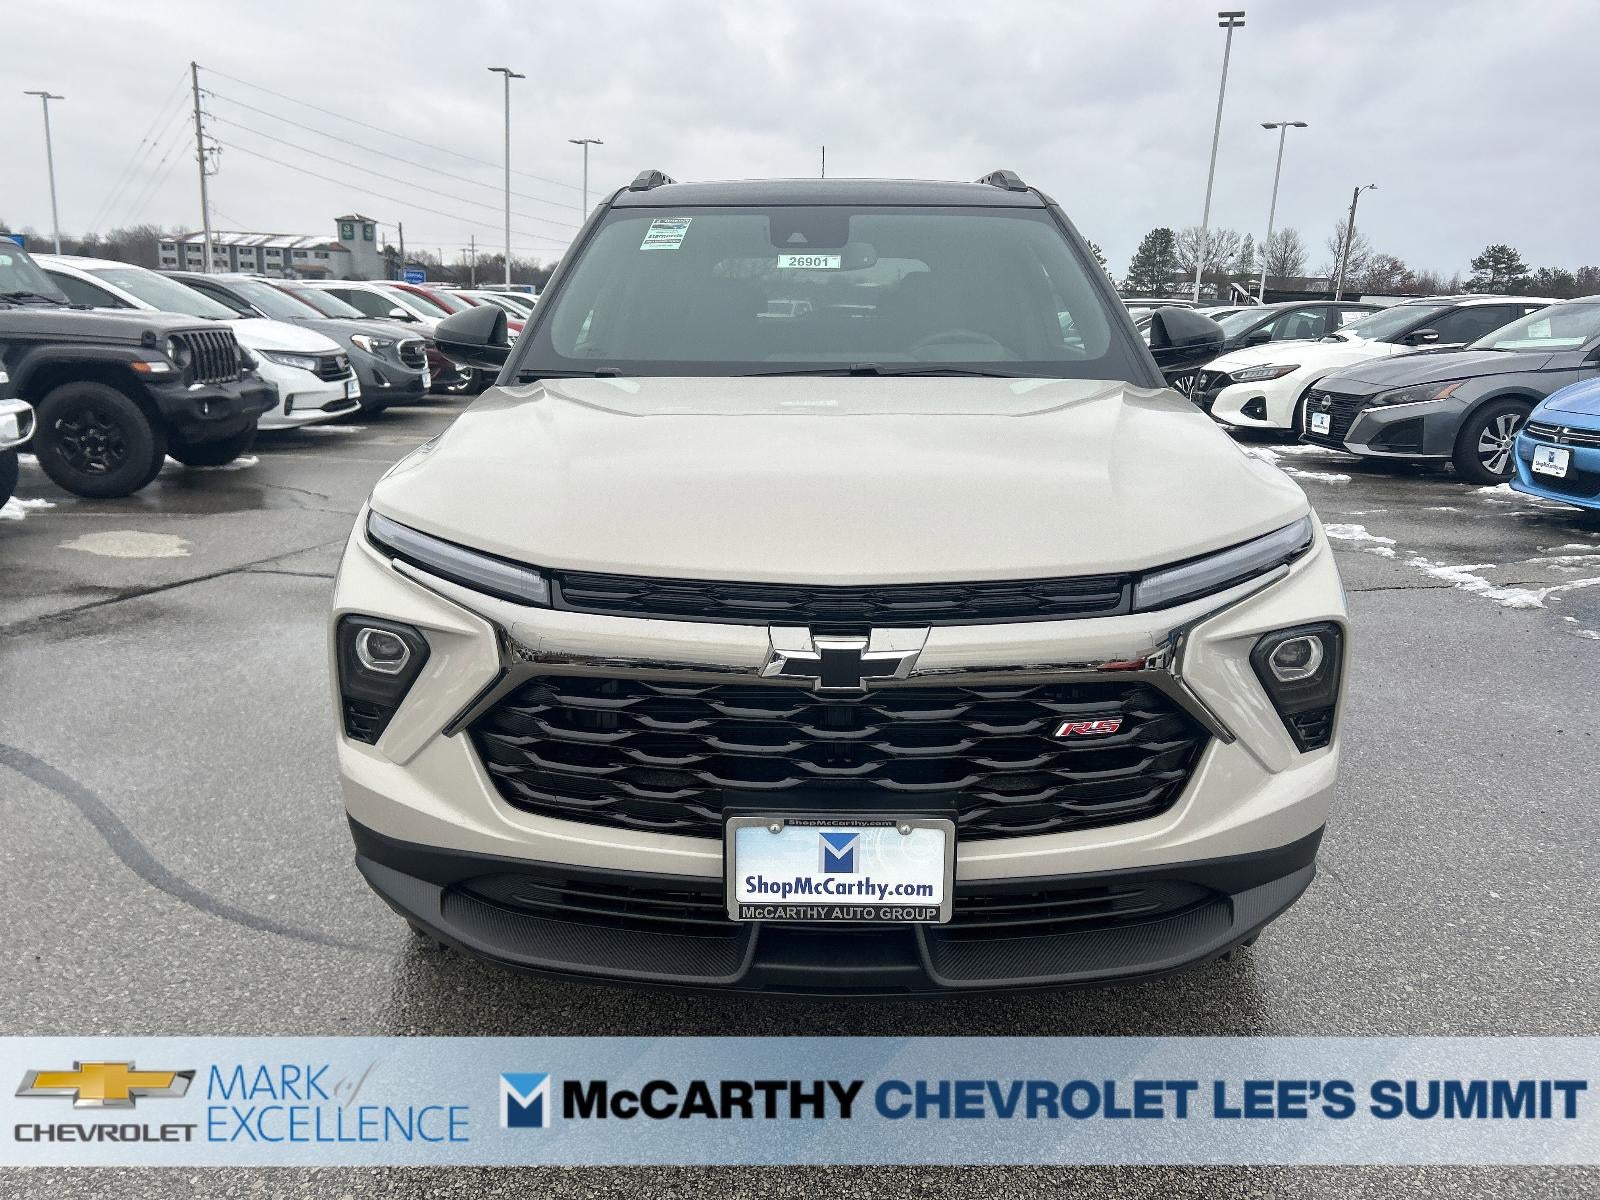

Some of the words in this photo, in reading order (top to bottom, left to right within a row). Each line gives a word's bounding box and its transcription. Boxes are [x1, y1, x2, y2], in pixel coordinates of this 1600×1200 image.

[788, 256, 828, 267] 26901
[1055, 719, 1122, 737] RS
[788, 819, 893, 827] ShopMcCarthy.com
[745, 875, 933, 900] ShopMcCarthy.com
[742, 907, 828, 919] McCARTHY
[831, 907, 875, 919] AUTO
[879, 908, 937, 920] GROUP
